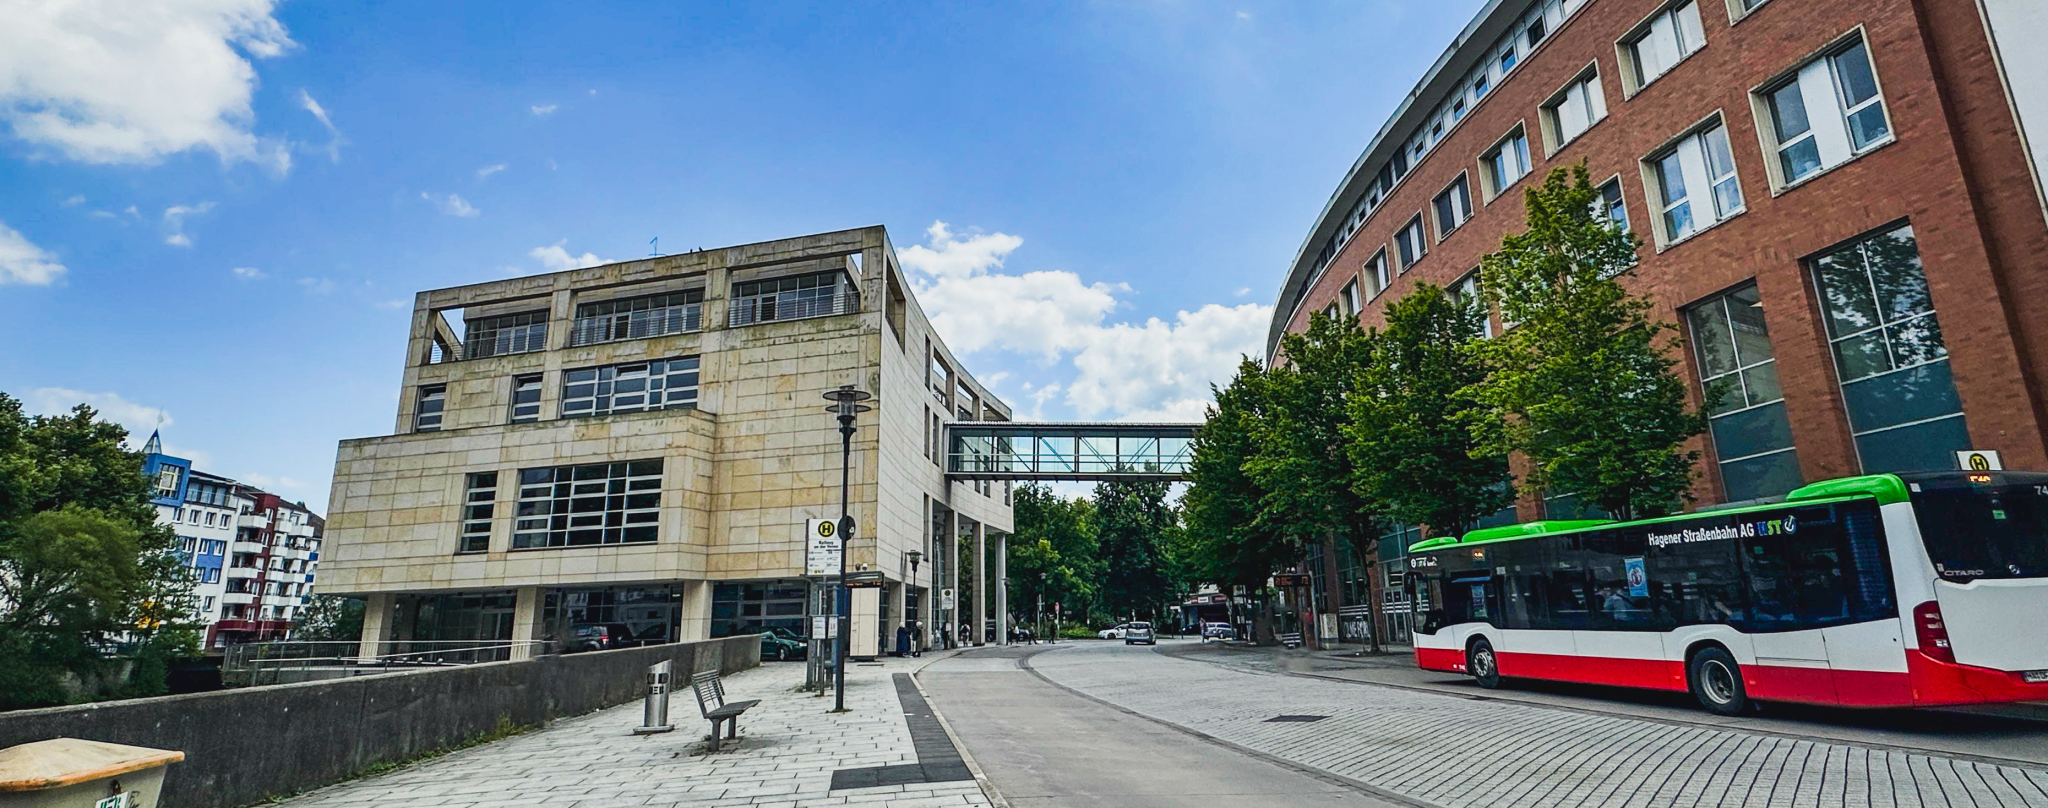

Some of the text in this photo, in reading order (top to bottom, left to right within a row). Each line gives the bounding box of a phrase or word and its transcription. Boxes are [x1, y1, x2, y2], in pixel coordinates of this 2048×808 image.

[1648, 521, 1755, 548] Hagener Straßenbahn AG
